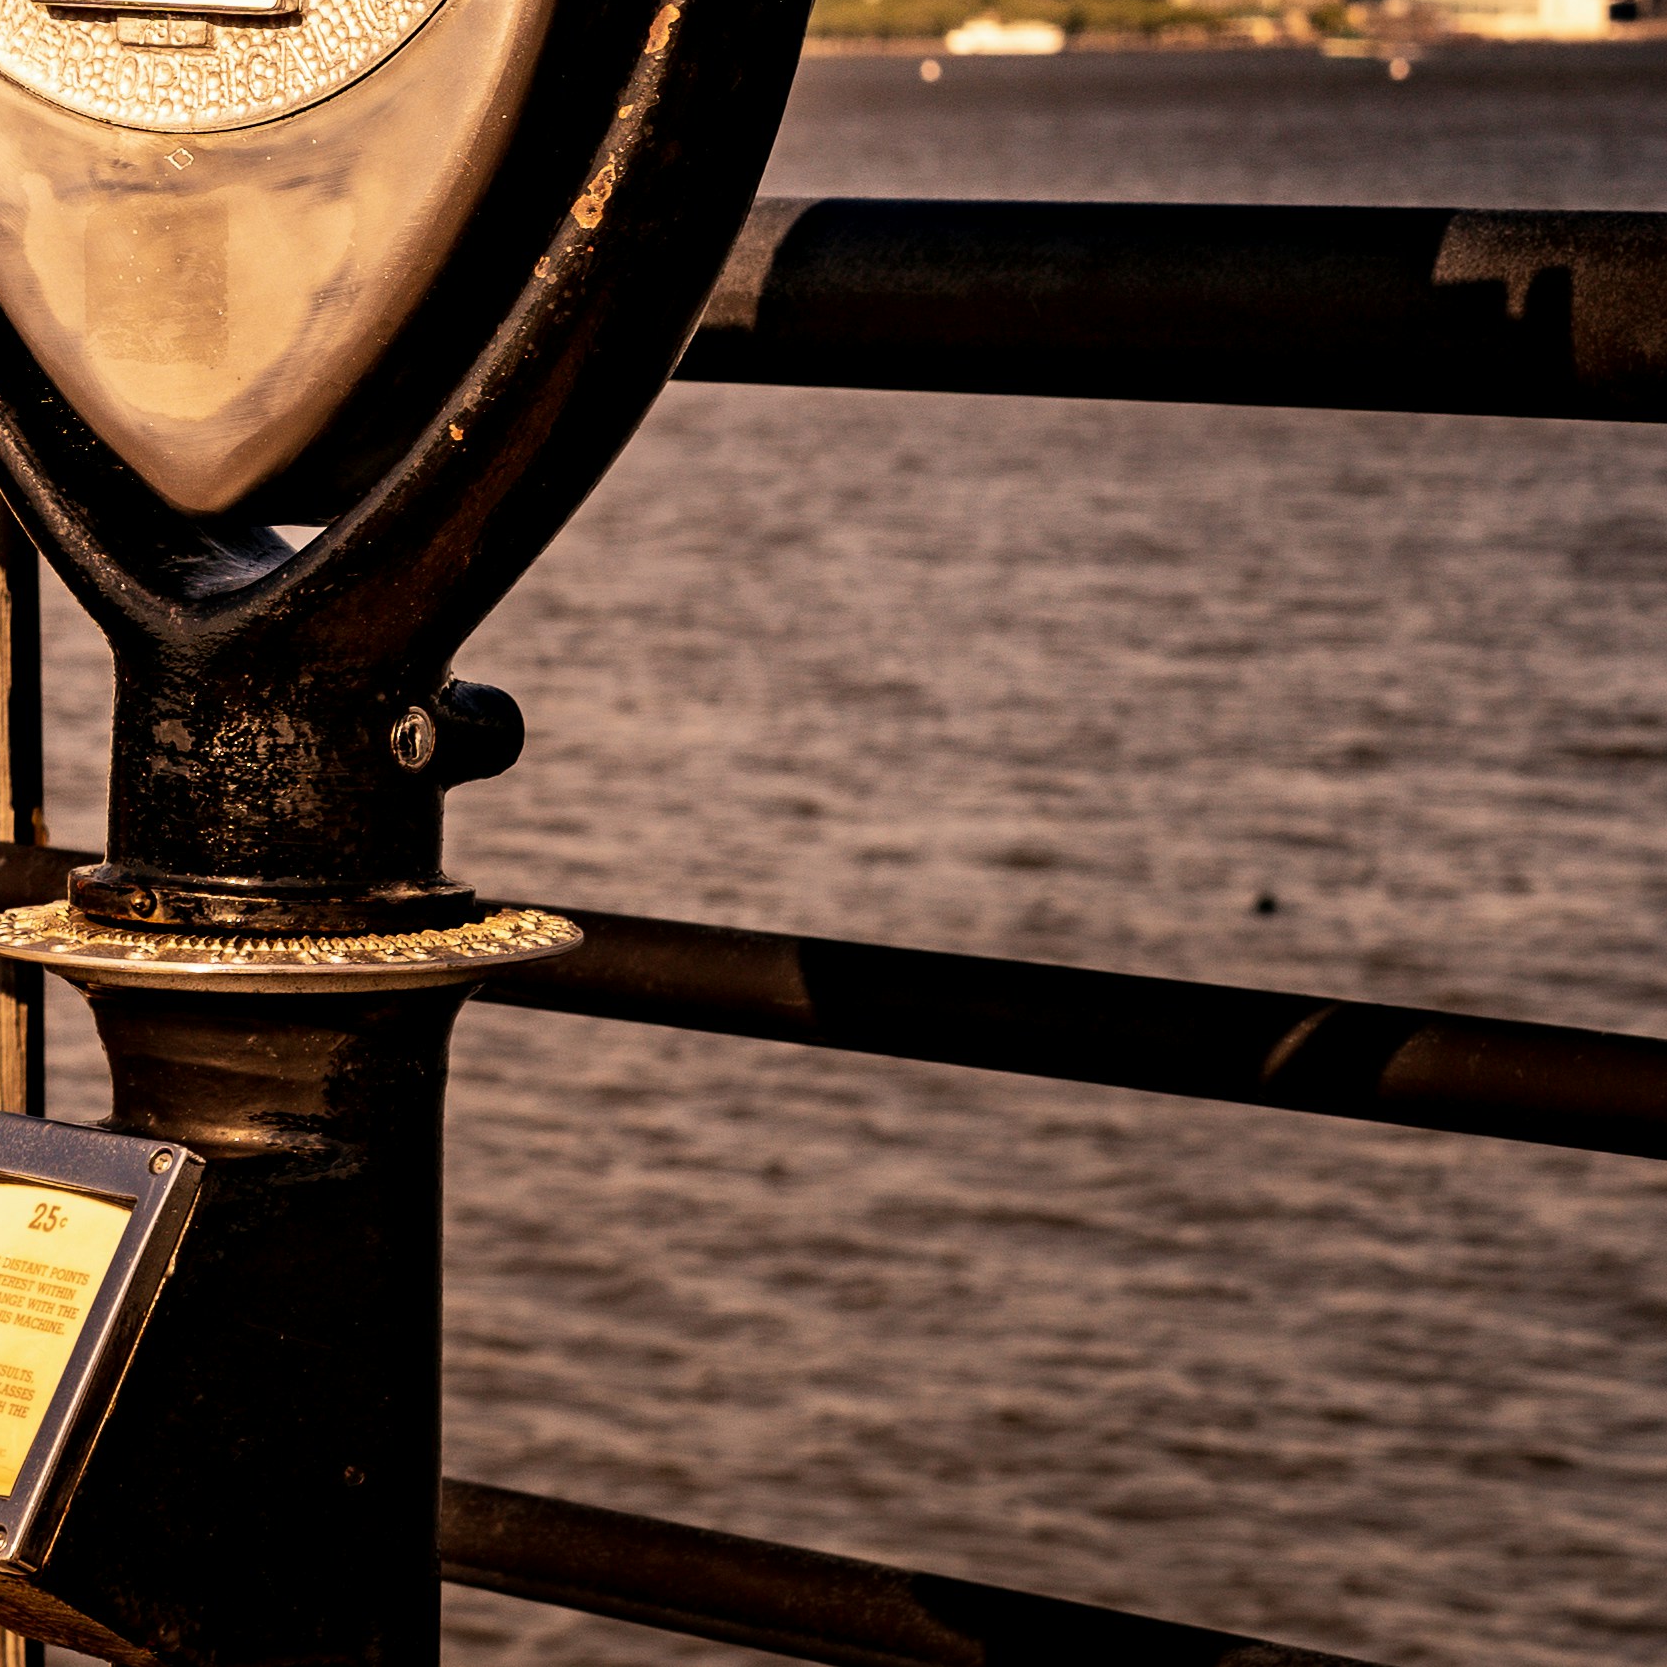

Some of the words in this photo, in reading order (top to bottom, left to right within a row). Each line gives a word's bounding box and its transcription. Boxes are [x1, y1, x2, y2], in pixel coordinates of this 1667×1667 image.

[114, 22, 350, 109] OPTICAL
[2, 1257, 49, 1278] DISTANT
[49, 1266, 90, 1286] POINTS
[37, 1281, 77, 1301] WITHIN
[27, 1298, 55, 1314] WITH
[58, 1305, 80, 1320] THE
[15, 1313, 65, 1335] MACHINE.
[7, 1403, 30, 1419] THE
